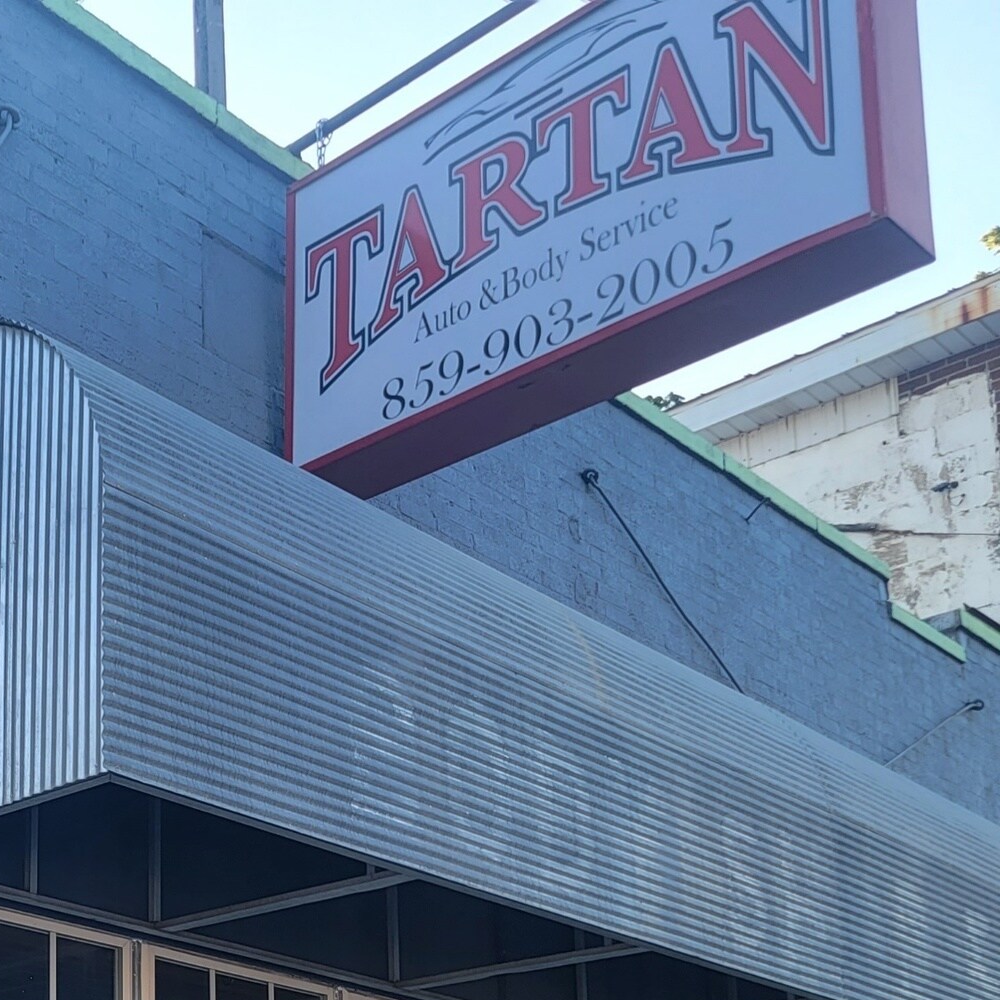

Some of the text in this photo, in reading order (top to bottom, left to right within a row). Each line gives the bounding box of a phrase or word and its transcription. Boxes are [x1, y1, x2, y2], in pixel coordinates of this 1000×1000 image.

[305, 0, 836, 395] TARTAN
[413, 300, 472, 344] Auto
[578, 196, 680, 262] Service
[381, 217, 735, 421] 859-903-2005
